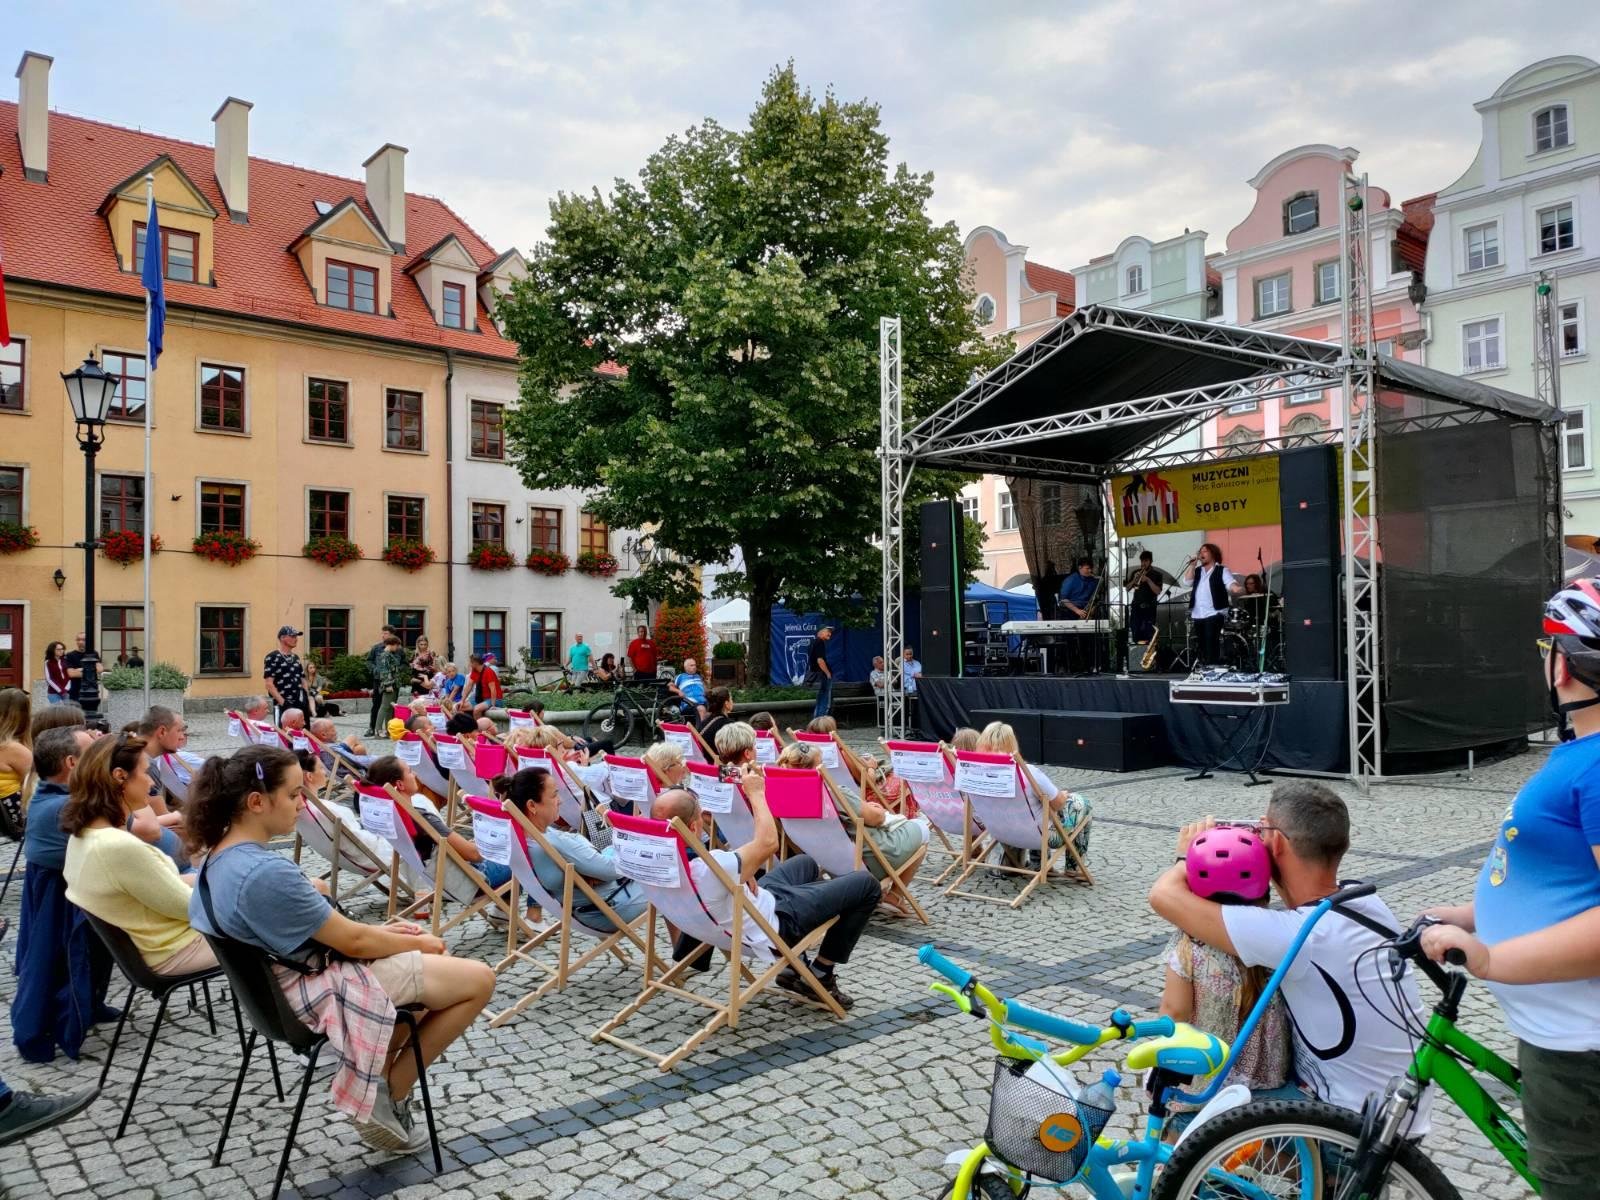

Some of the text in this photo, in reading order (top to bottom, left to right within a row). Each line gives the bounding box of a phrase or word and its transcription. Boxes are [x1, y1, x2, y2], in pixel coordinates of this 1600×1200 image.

[1192, 466, 1249, 483] MUZYCZNI
[1192, 483, 1209, 491] Plac
[1211, 479, 1250, 489] Ratuszowy
[1195, 498, 1248, 514] SOBOTY
[784, 622, 817, 632] Jelenia Góra
